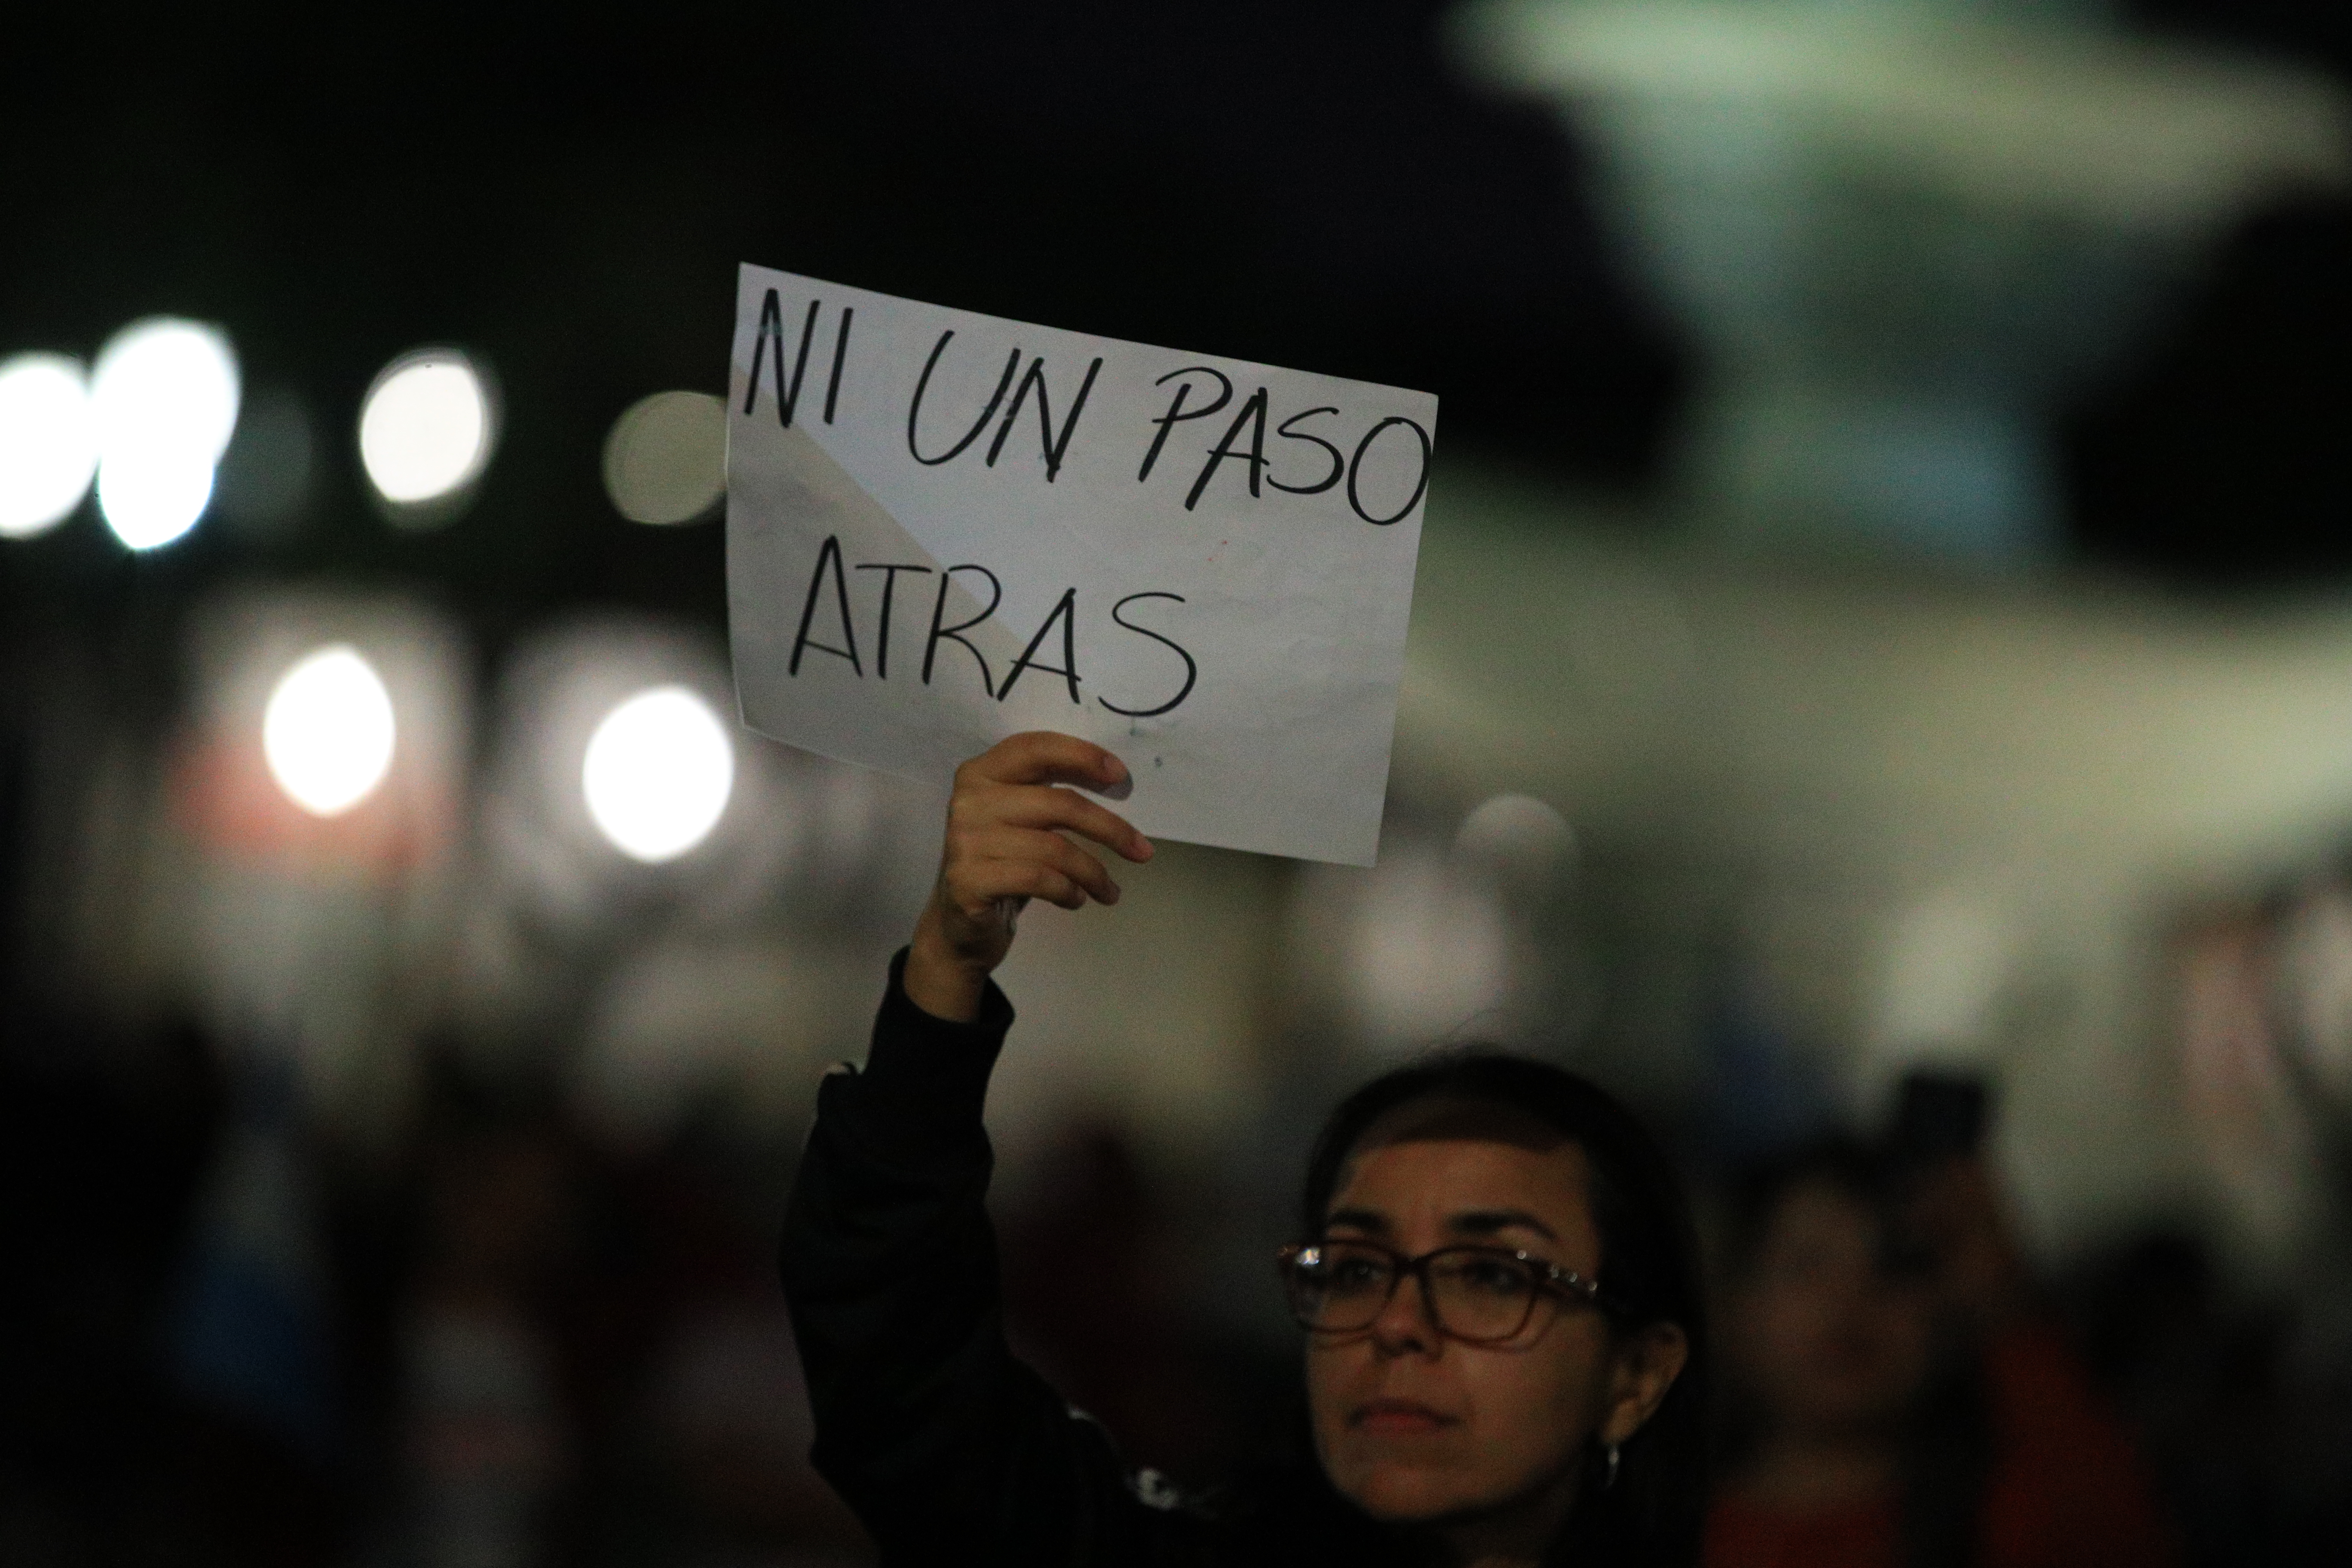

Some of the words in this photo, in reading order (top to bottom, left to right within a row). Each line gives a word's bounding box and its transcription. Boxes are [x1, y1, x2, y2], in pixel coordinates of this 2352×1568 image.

[743, 288, 854, 429] NI
[908, 330, 1103, 483] UN
[1138, 366, 1432, 526] PASO
[787, 535, 1197, 717] ATRAS
